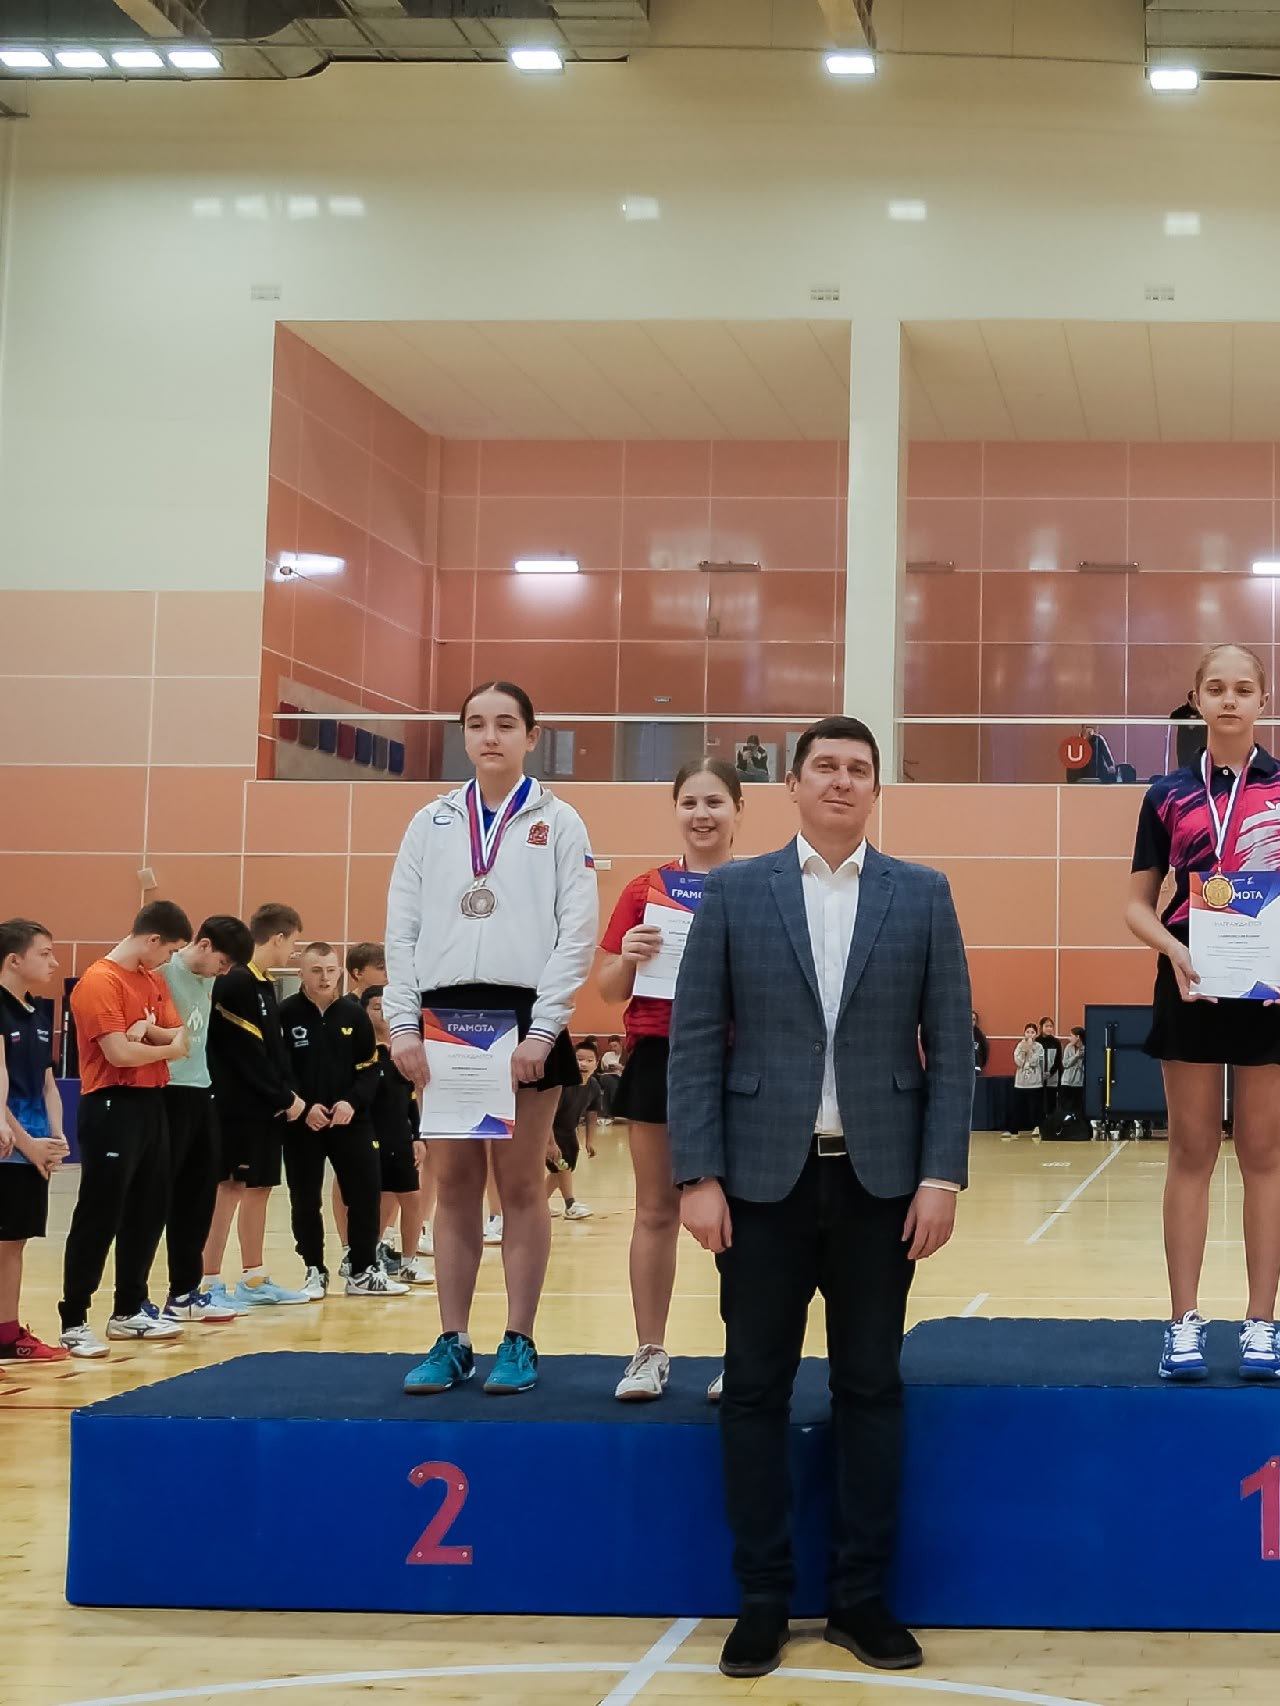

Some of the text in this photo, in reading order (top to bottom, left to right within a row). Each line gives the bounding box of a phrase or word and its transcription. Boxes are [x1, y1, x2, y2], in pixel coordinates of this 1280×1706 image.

[671, 888, 703, 899] ГРАМ
[1233, 890, 1264, 900] МОТА
[447, 1023, 495, 1032] ГРАМОТА
[406, 1460, 473, 1565] 2
